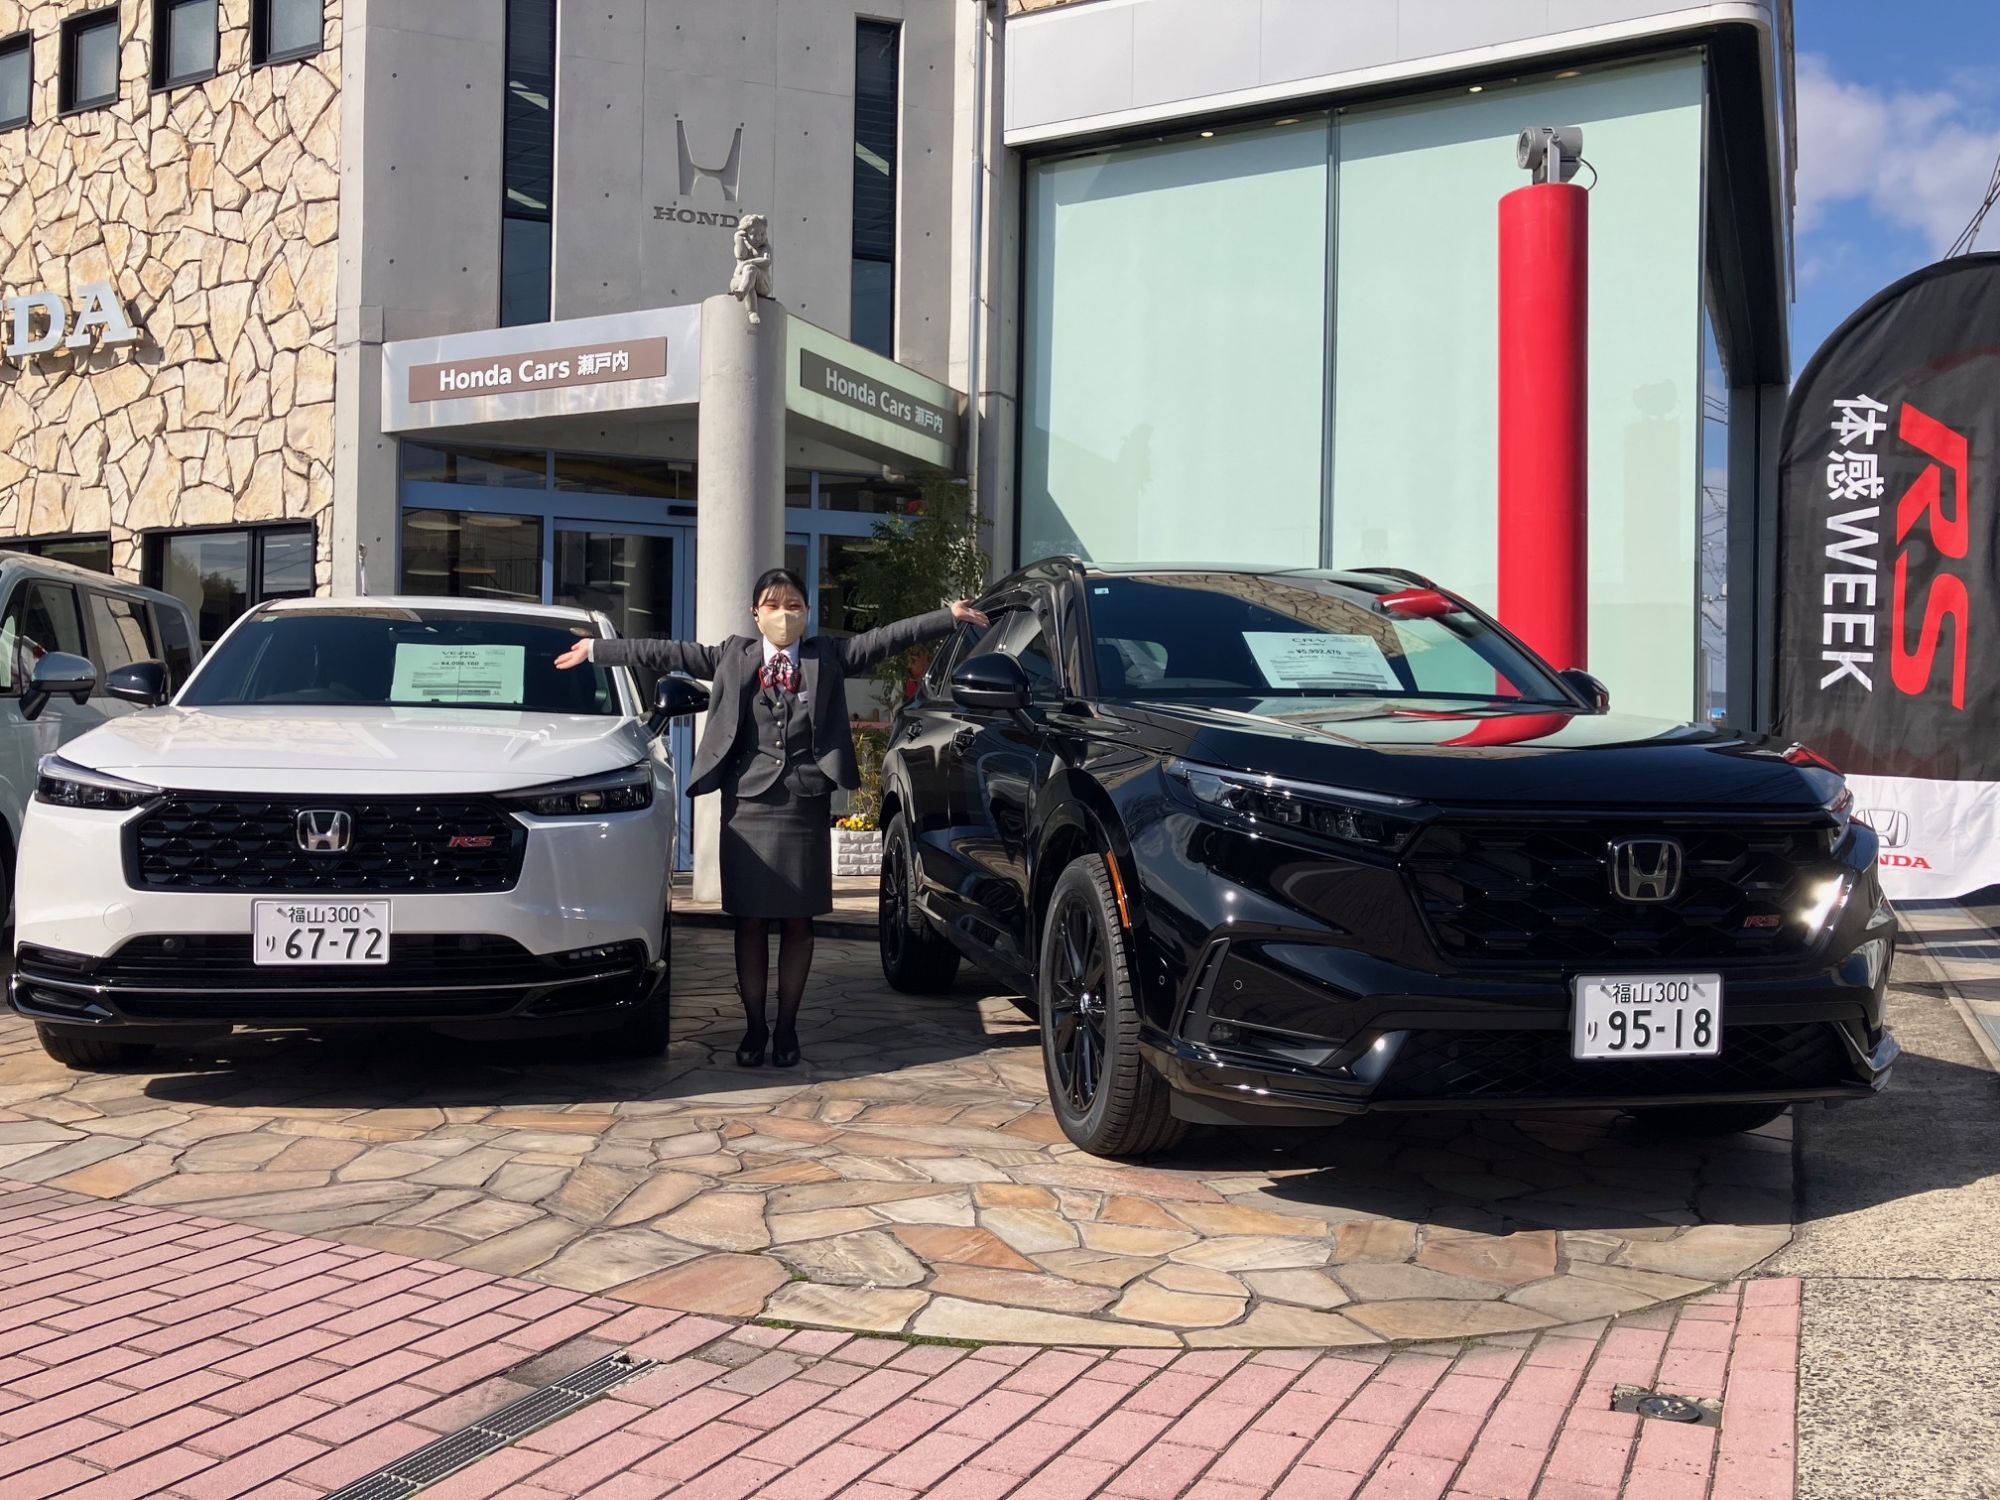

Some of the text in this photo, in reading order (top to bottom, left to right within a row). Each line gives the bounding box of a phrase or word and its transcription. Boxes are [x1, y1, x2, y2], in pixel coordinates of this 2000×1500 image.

[653, 206, 741, 228] HOND
[6, 281, 138, 357] DA
[439, 350, 629, 391] Honda Cars 瀬戸内
[826, 367, 943, 433] Honda Cars 瀬戸内
[1891, 401, 1968, 711] RS
[448, 836, 495, 847] RS
[1879, 854, 1932, 869] NDA
[1743, 914, 1781, 928] RS
[285, 928, 383, 959] 67-72
[1607, 1008, 1711, 1050] 95-18
